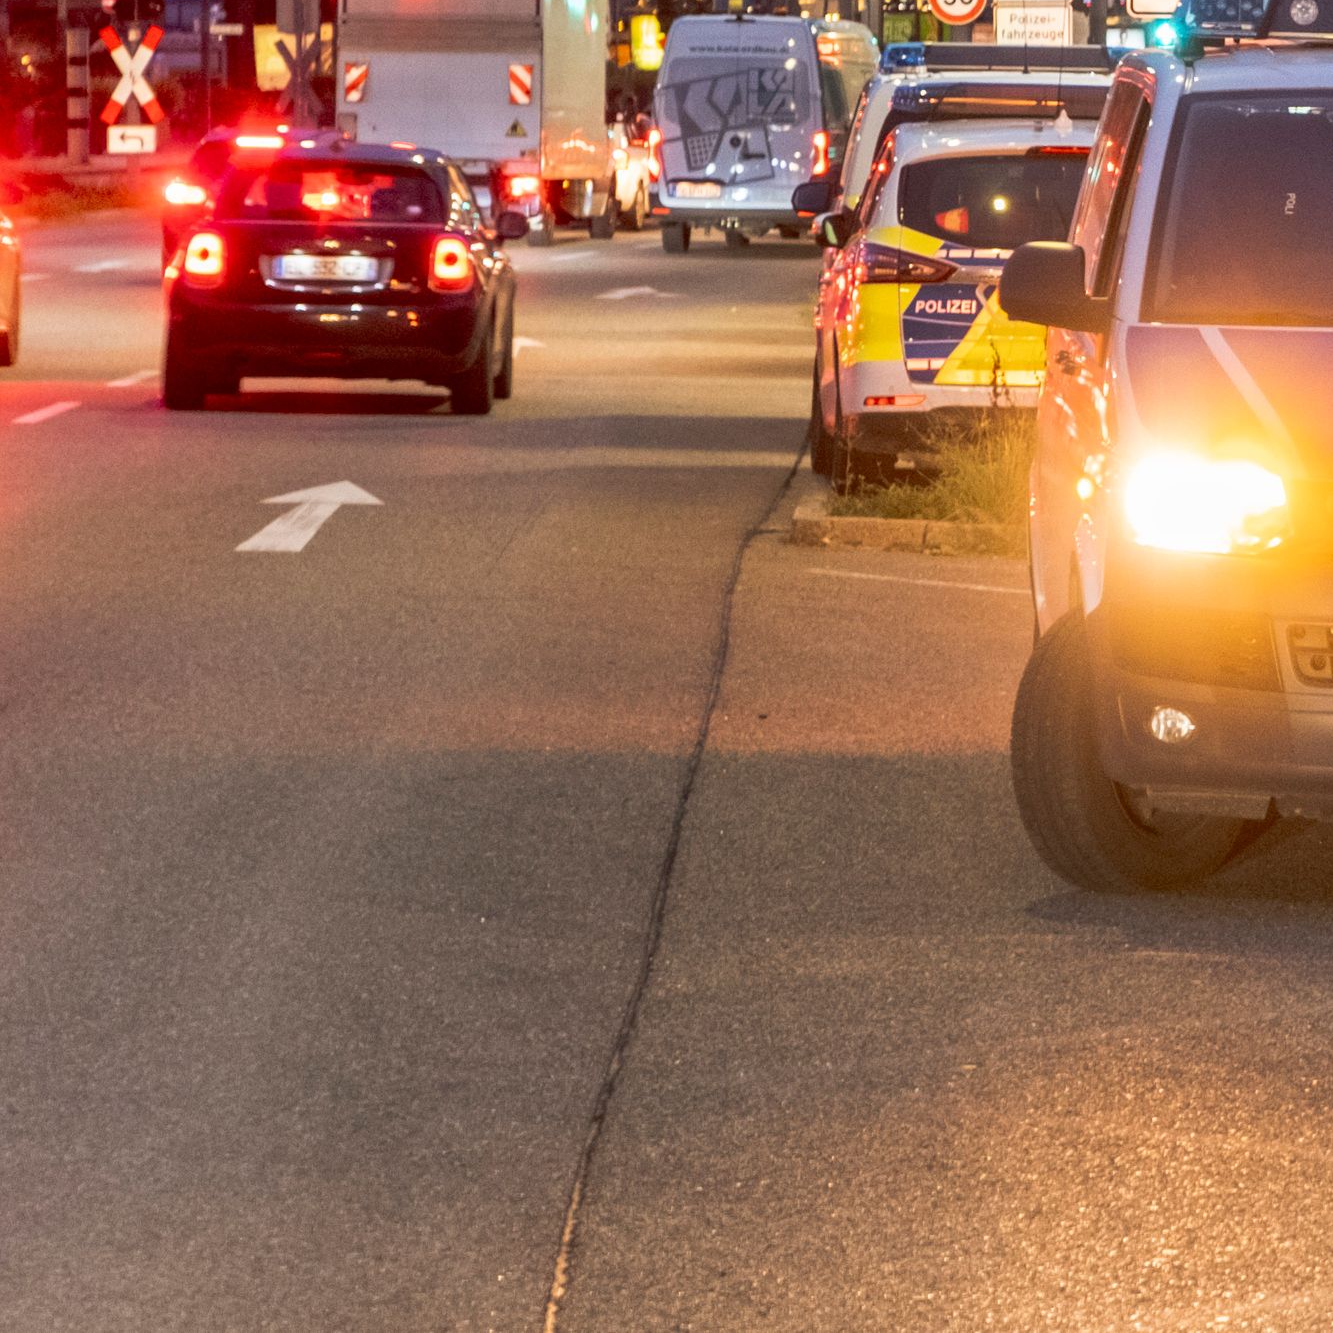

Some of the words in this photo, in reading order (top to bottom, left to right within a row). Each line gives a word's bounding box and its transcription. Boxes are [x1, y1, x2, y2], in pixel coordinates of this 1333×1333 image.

[1009, 12, 1056, 25] Polizei-
[1001, 28, 1065, 41] fahrzeuge
[914, 298, 978, 315] POLIZEI
